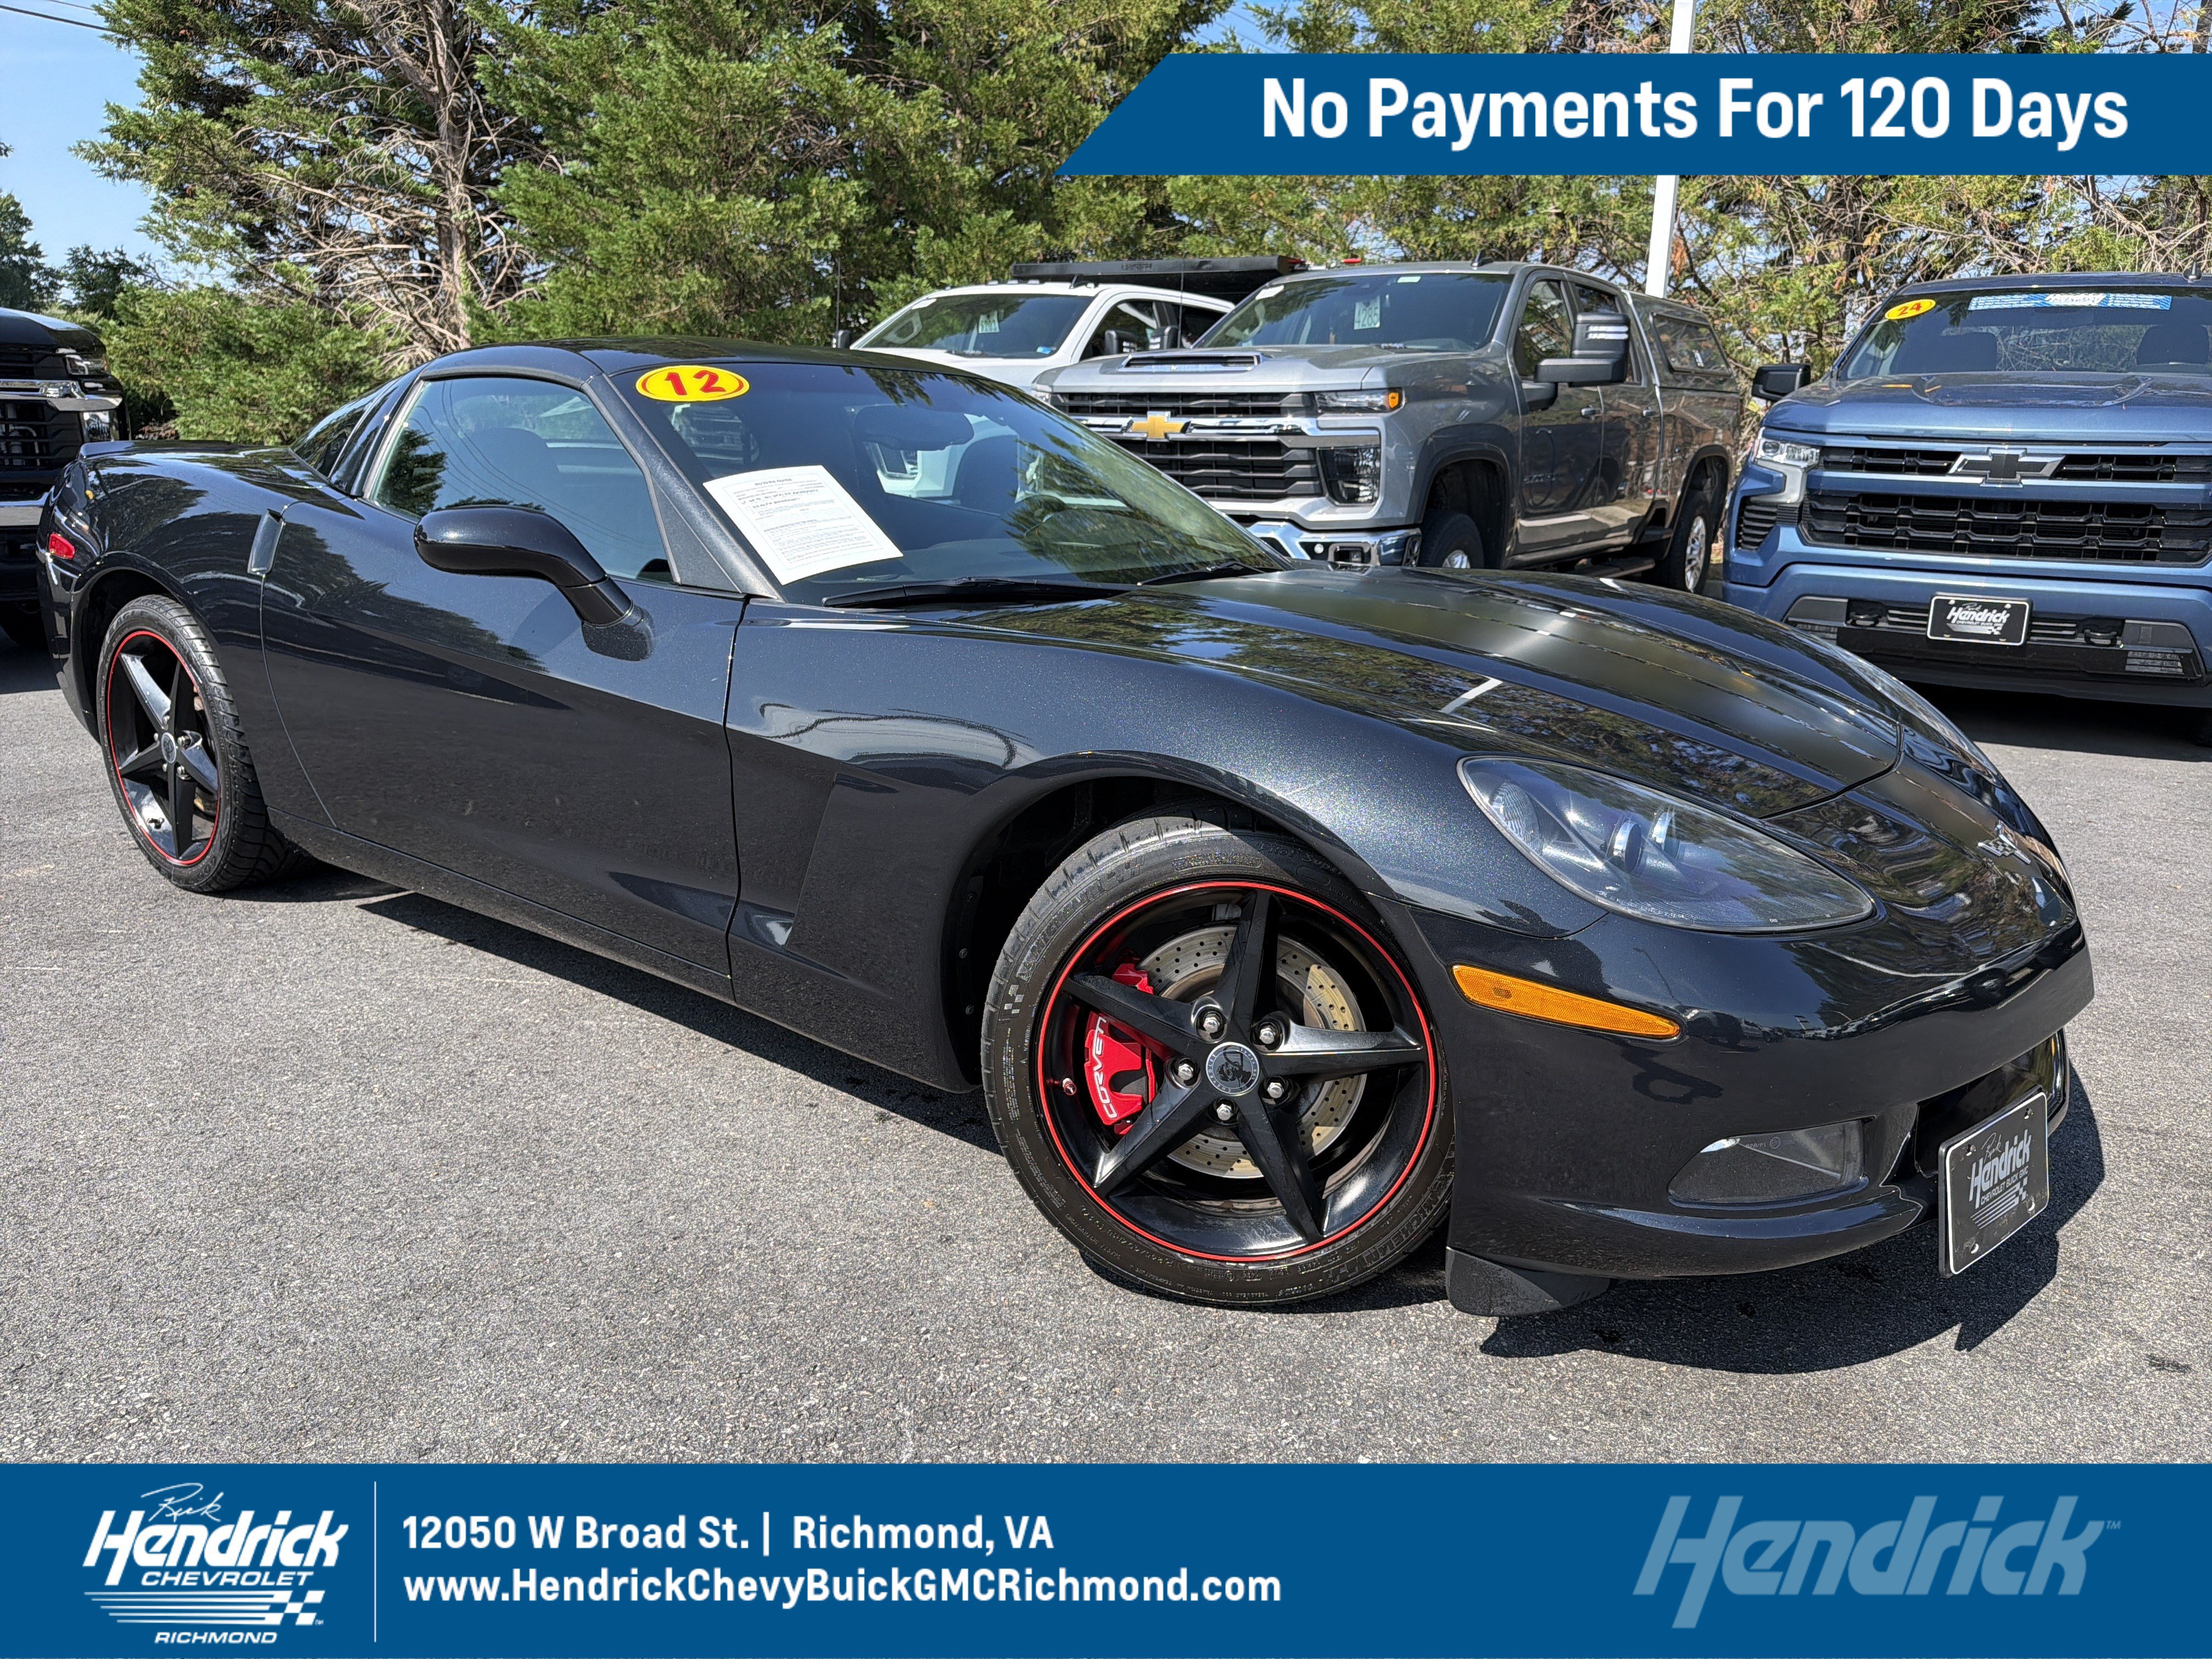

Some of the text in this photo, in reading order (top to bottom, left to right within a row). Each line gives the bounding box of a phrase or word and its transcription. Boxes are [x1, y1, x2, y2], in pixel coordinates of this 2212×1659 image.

[1898, 302, 1922, 317] 24
[665, 370, 726, 396] 12
[1946, 606, 2010, 624] Hendrick
[1092, 1016, 1118, 1119] CORVETT
[1968, 1128, 2032, 1209] Hendrick
[1980, 1165, 2029, 1205] CHEVROLET BUICK GMC
